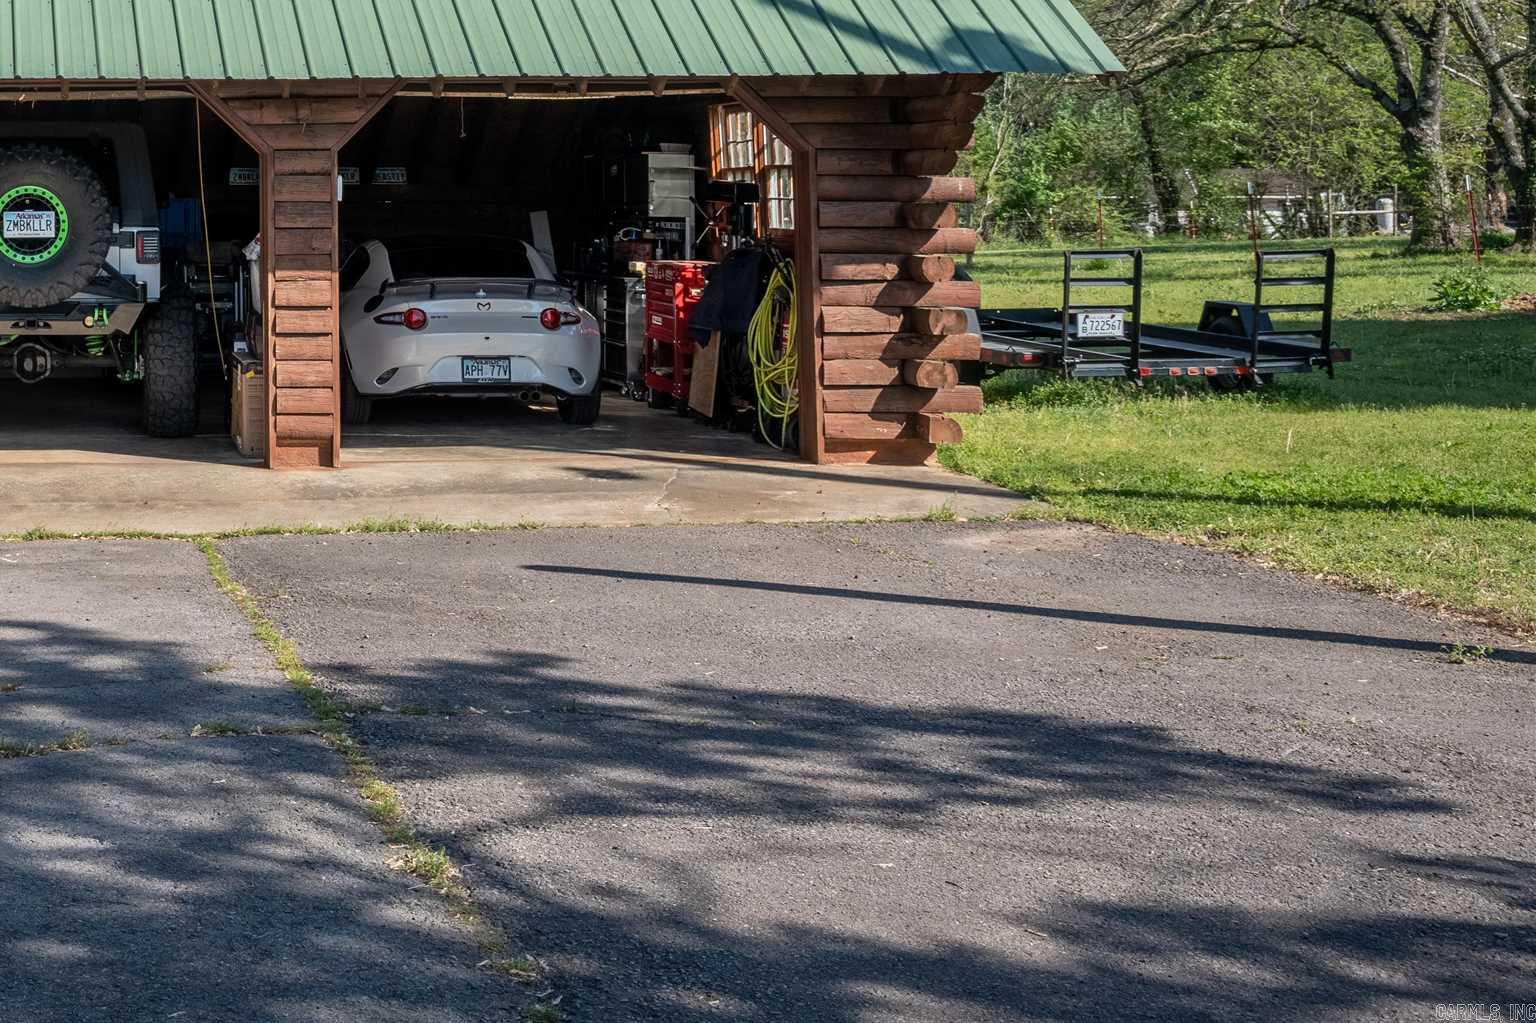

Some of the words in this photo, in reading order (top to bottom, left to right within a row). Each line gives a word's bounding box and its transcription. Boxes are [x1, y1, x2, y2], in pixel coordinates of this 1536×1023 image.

[6, 219, 52, 232] ZMBKLLR
[1089, 320, 1122, 331] 722567
[465, 365, 484, 376] APH
